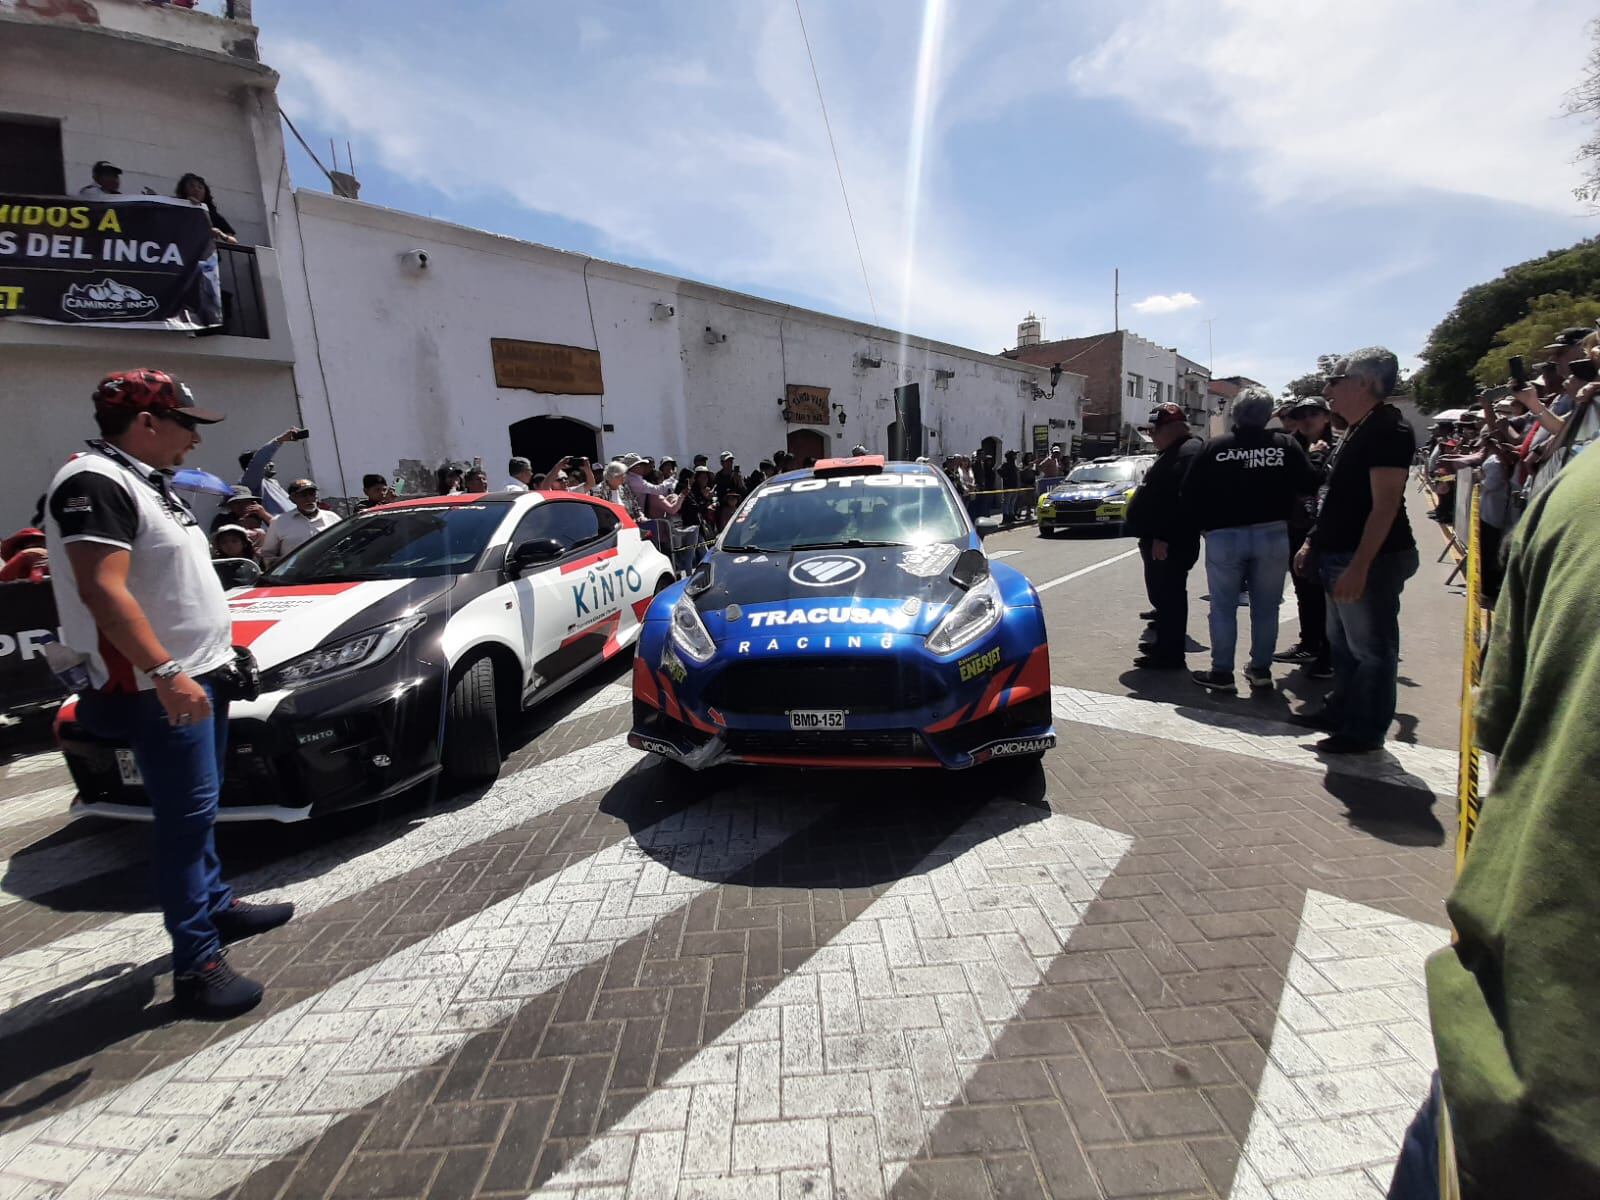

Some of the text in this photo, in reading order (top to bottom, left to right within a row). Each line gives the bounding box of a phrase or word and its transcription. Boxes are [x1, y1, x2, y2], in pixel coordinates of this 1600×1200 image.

[97, 208, 122, 233] A
[26, 233, 93, 260] DEL
[103, 238, 184, 267] INCA
[66, 299, 155, 310] CAMINOS INCA
[1215, 447, 1285, 462] CAMINOS
[1249, 456, 1284, 468] INCA
[755, 473, 939, 498] FOTON
[738, 632, 894, 653] RACING
[960, 646, 1001, 682] ENERJET
[793, 713, 842, 727] BMD-152
[299, 729, 333, 744] KINTO
[990, 738, 1052, 756] YOKOHAMA
